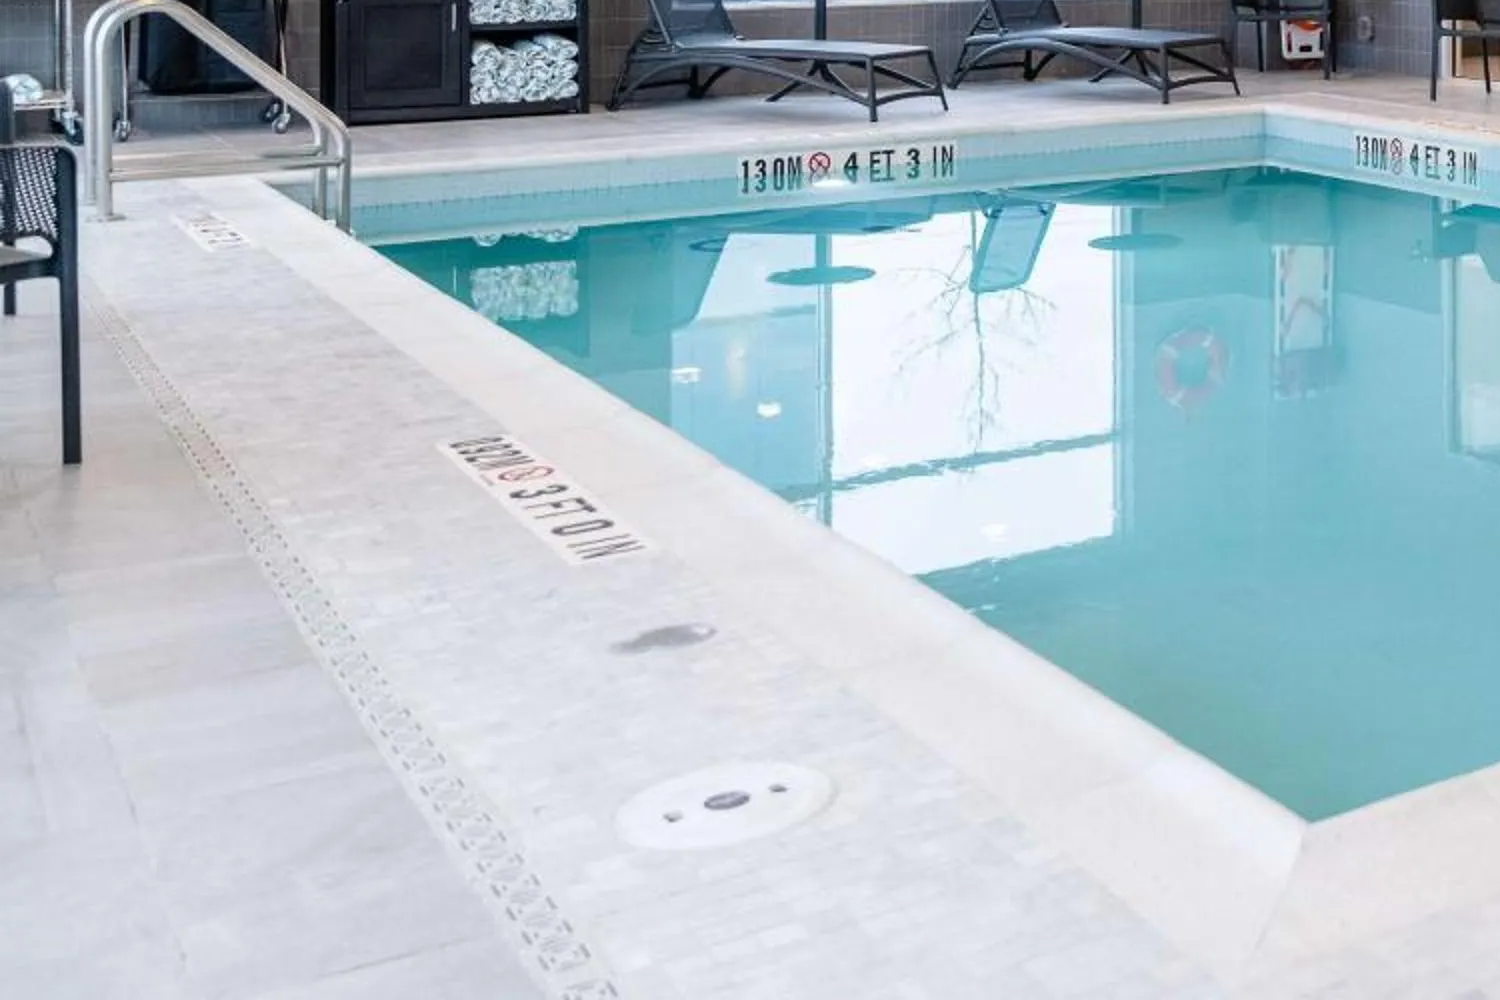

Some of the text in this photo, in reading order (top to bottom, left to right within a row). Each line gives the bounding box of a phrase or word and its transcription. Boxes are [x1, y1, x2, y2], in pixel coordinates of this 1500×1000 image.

[509, 483, 570, 499] 3
[522, 496, 597, 519] FT
[566, 532, 648, 560] IN
